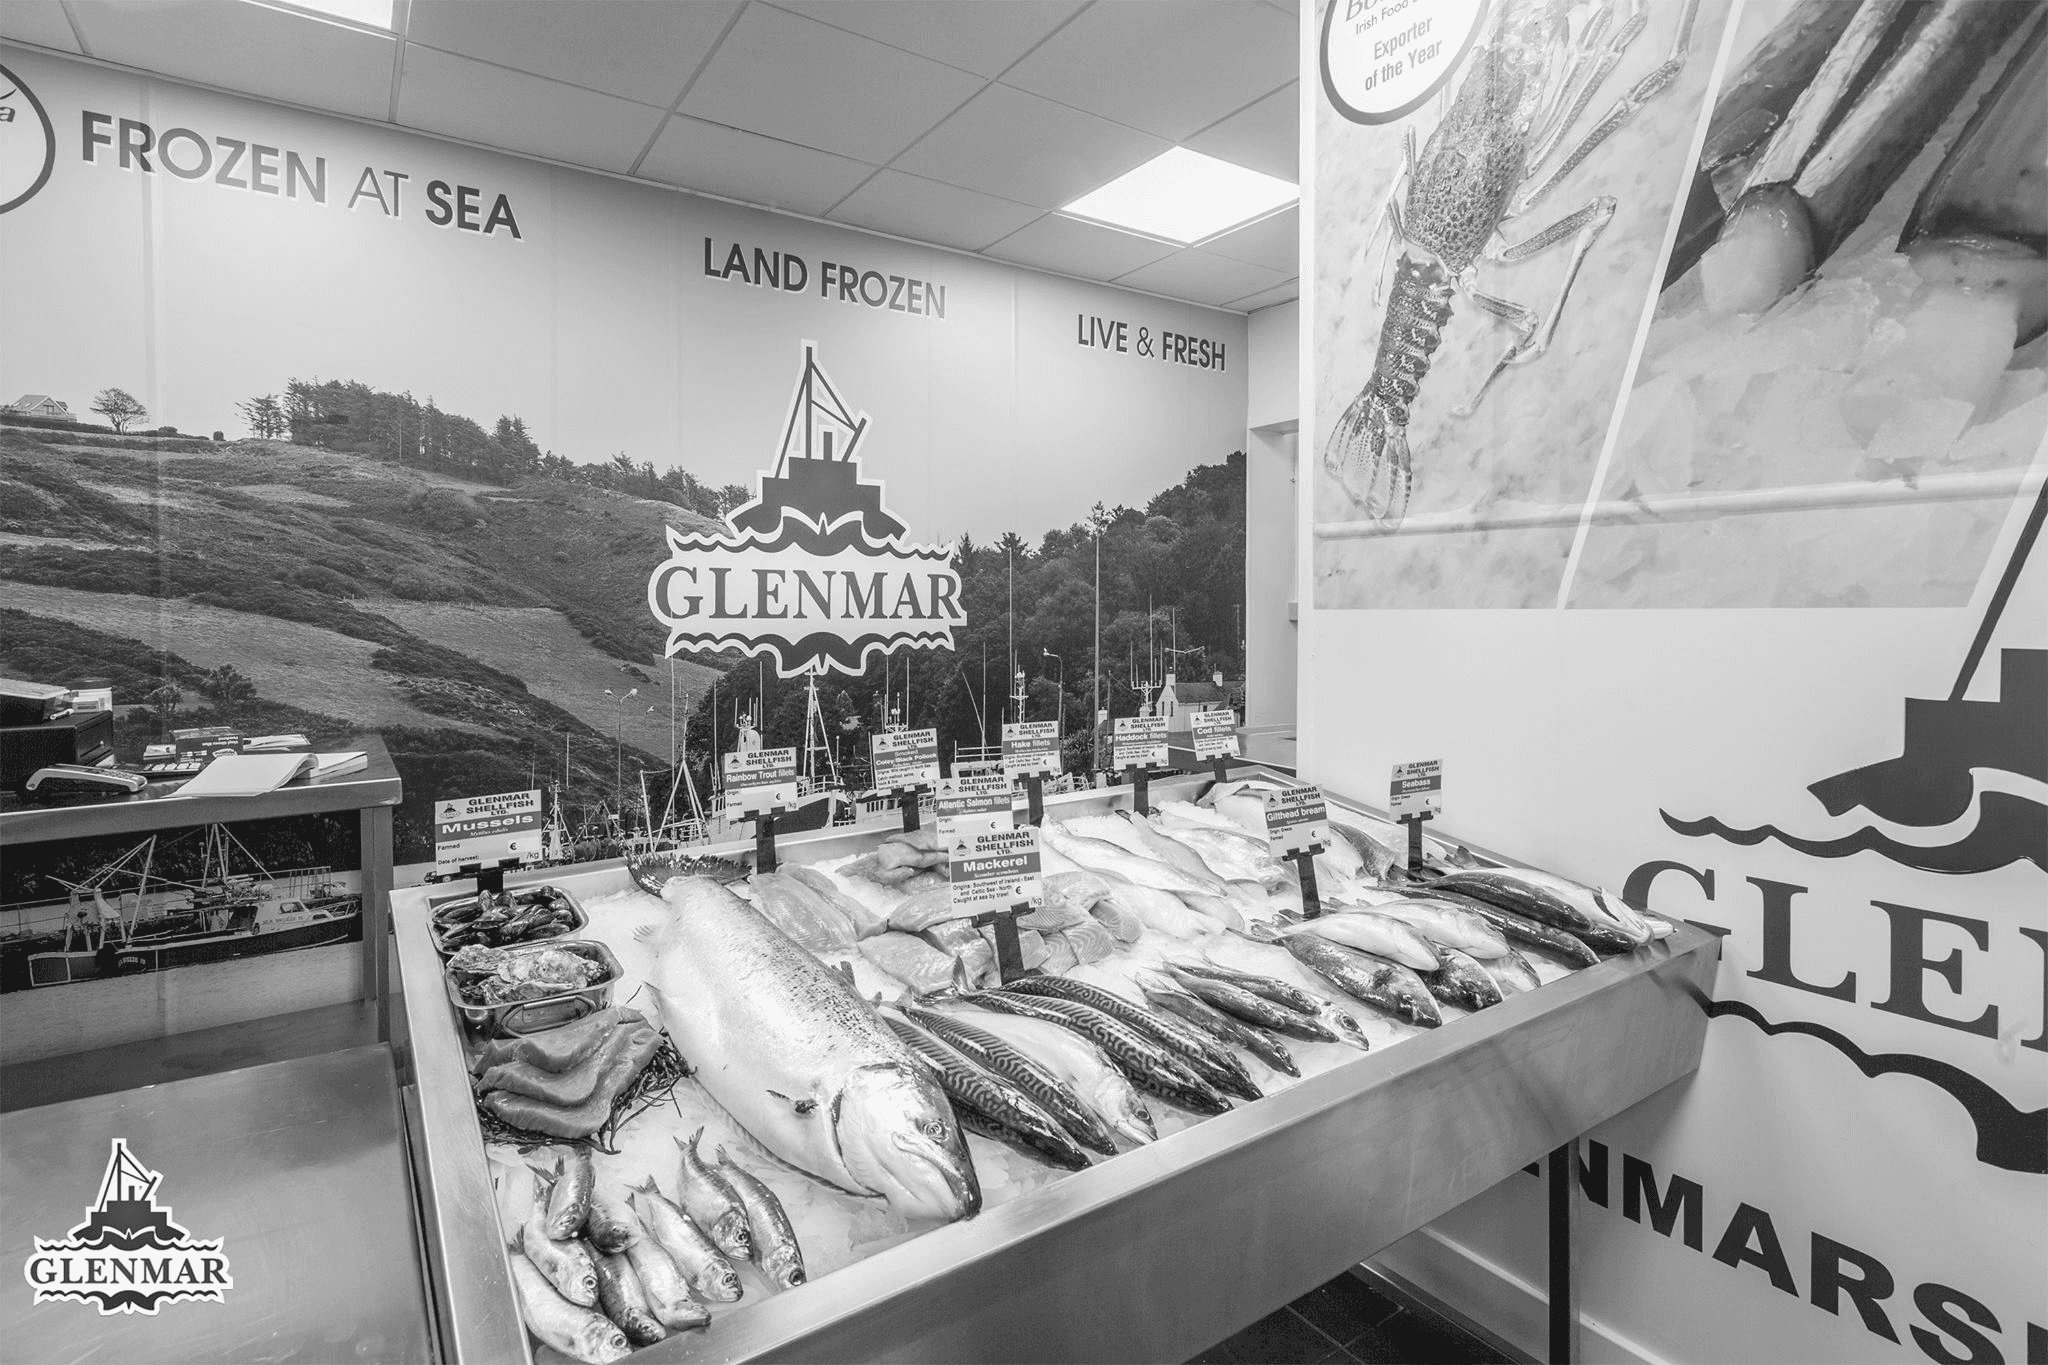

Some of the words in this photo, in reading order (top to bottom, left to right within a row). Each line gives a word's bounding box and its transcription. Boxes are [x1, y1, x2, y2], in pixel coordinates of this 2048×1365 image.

[1356, 14, 1378, 36] Irish
[1374, 17, 1432, 60] Exporter
[1365, 68, 1378, 91] of
[1382, 60, 1403, 83] the
[1408, 40, 1442, 68] Year
[82, 110, 326, 204] FROZEN
[348, 166, 409, 218] AT
[425, 179, 522, 240] SEA
[704, 237, 808, 292] LAND
[821, 260, 946, 319] FROZEN
[1078, 314, 1128, 353] LIVE
[1136, 326, 1154, 358] &
[1162, 331, 1226, 371] FRESH
[655, 565, 962, 620] GLENMAR
[1204, 716, 1232, 724] SHELLFISH
[893, 731, 930, 740] GLENMAR
[1115, 734, 1148, 742] Haddock
[892, 737, 933, 747] SHELLFISH
[748, 750, 789, 758] GLENMAR
[746, 756, 792, 766] SHELLFISH
[1408, 760, 1438, 769] GLENMAR
[726, 773, 757, 782] Rainbow
[758, 770, 777, 779] Trout
[1407, 766, 1440, 775] SHELLFISH
[960, 777, 1004, 785] GLENMAR
[1402, 779, 1430, 788] Seabass
[958, 783, 1007, 793] SHELLFISH
[1282, 786, 1318, 797] GLENMAR
[468, 793, 530, 806] GLENMAR
[939, 800, 965, 810] Atlantic
[967, 798, 992, 807] Salmon
[994, 796, 1010, 804] fillets
[1281, 792, 1321, 804] SHELLFISH
[466, 800, 534, 814] SHELLFISH
[1266, 808, 1300, 822] Gilthead
[1302, 805, 1325, 817] bream
[442, 815, 533, 834] Mussels
[977, 832, 1030, 844] GLENMAR
[438, 843, 460, 851] Farmed
[510, 842, 517, 850] €
[975, 840, 1034, 852] SHELLFISH
[963, 856, 1028, 872] Mackerel
[973, 880, 998, 888] Southwest
[1015, 886, 1022, 895] €
[1030, 896, 1042, 905] /kg
